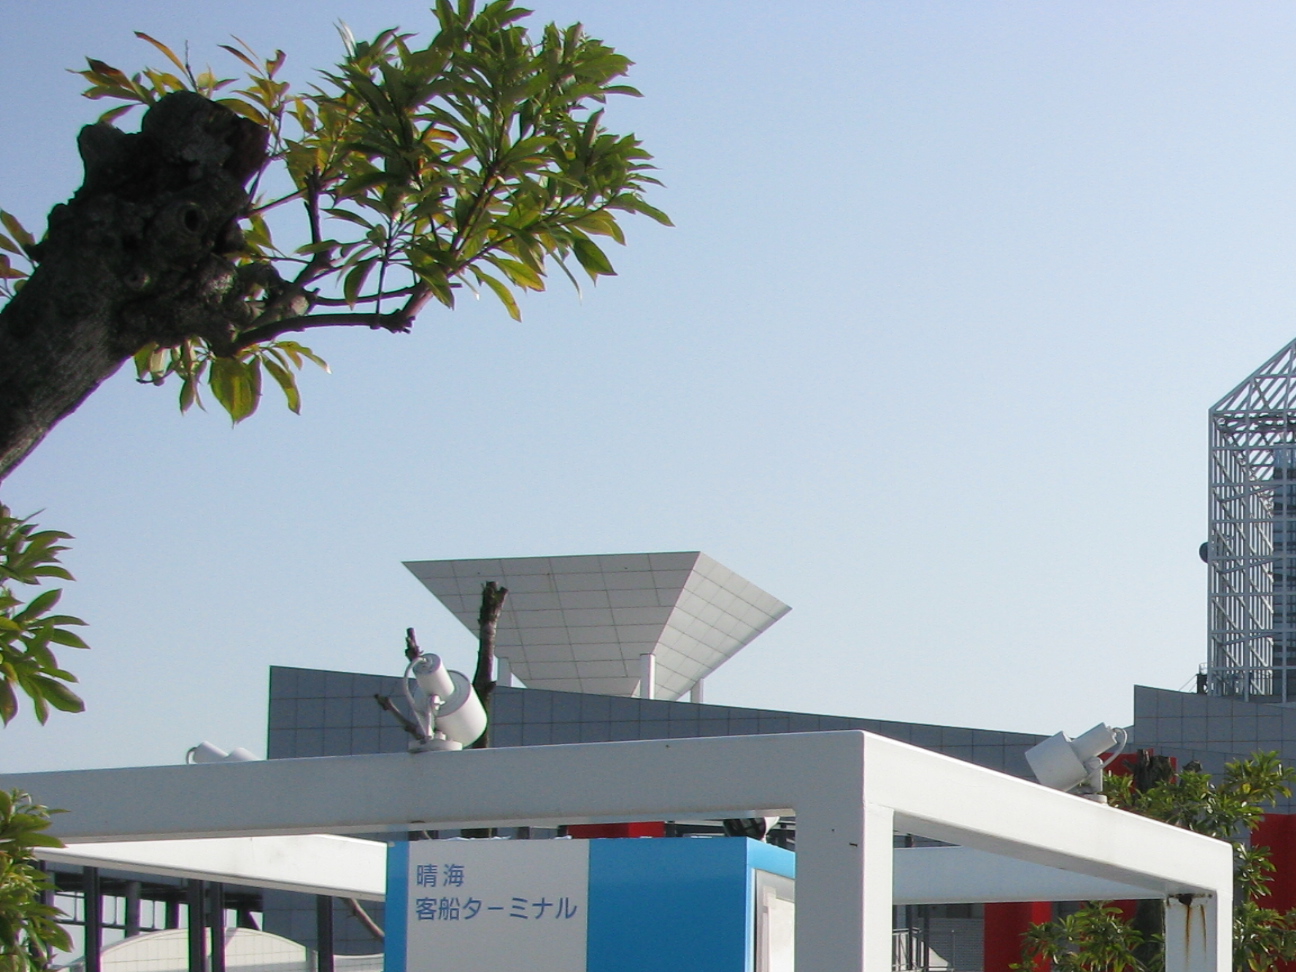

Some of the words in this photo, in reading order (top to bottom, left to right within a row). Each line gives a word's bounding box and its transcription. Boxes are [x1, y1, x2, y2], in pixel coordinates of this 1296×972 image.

[416, 863, 464, 888] 晴海
[415, 896, 578, 921] 客船ターミナル
